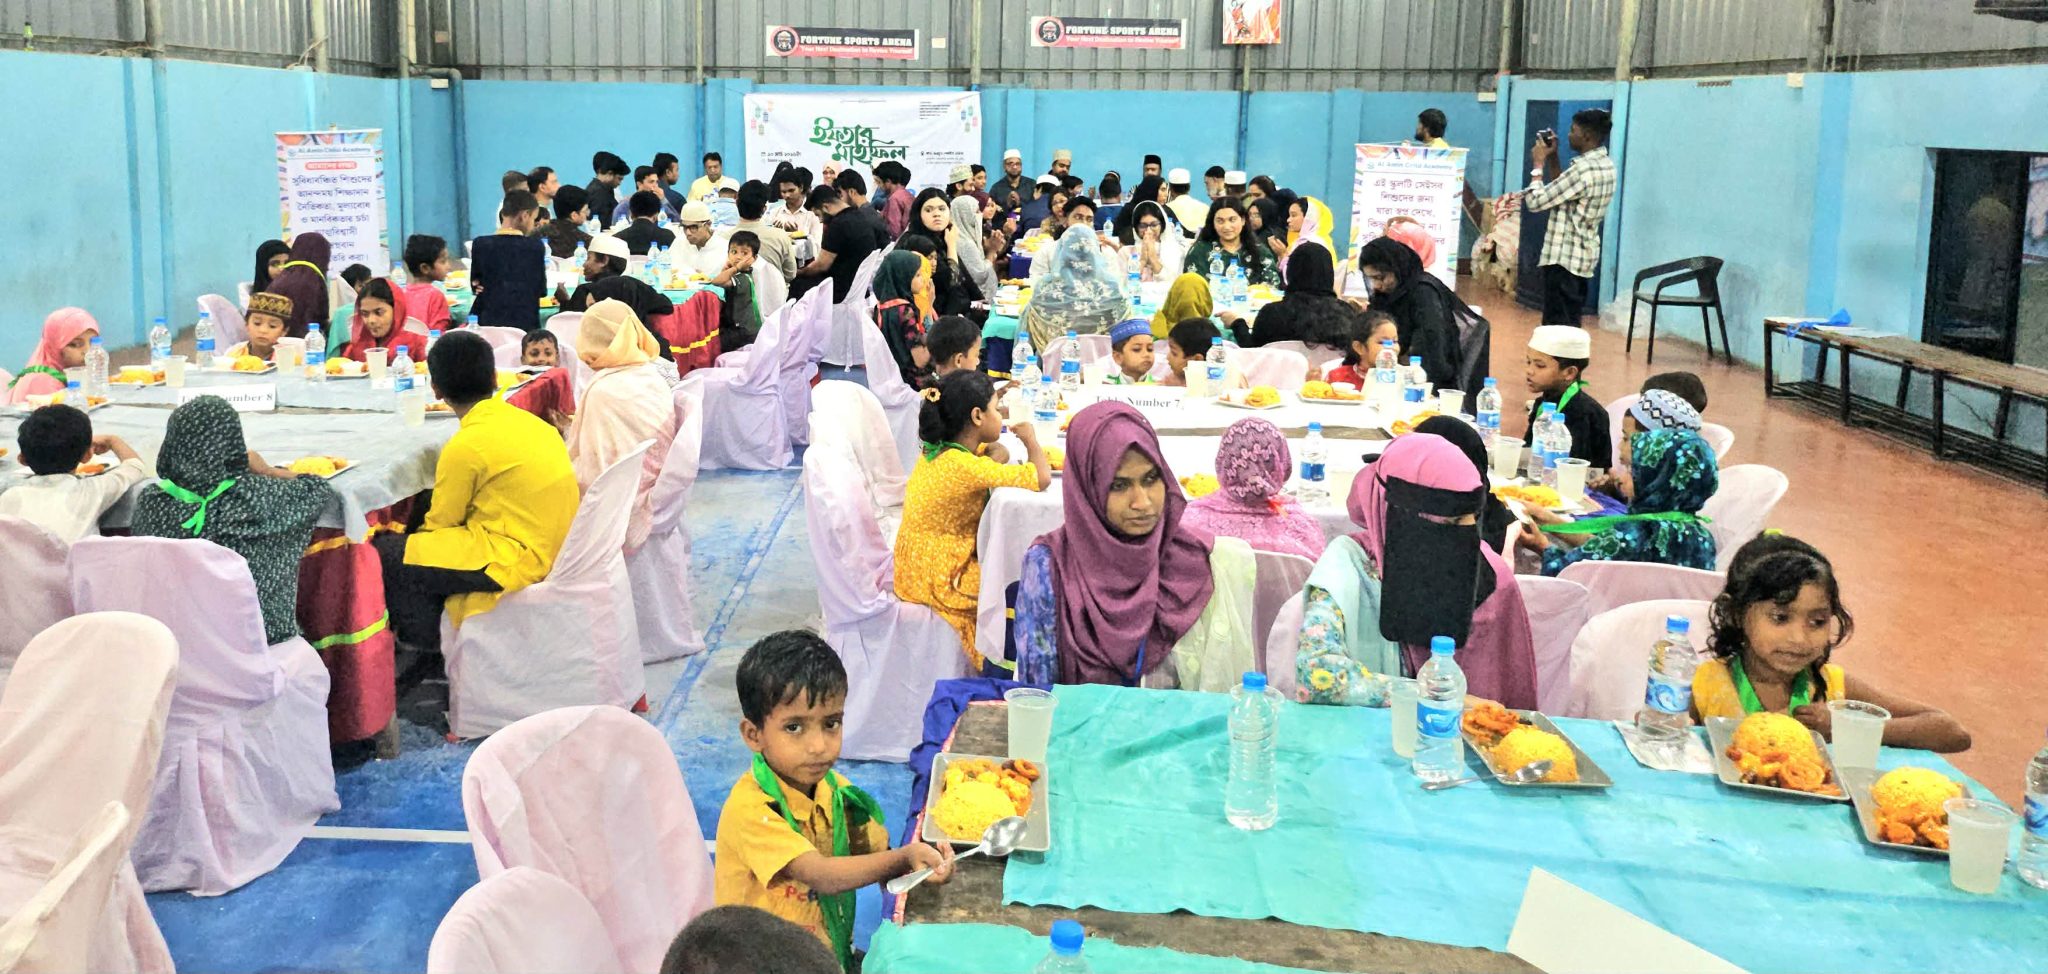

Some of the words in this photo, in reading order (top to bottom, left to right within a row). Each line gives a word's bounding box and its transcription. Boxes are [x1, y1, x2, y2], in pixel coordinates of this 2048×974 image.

[1065, 26, 1107, 34] FORTUNE
[1110, 26, 1145, 35] SPORTS
[1148, 27, 1179, 36] ARENA
[800, 35, 842, 44] FORTUNE
[844, 36, 879, 45] SPORTS
[882, 37, 912, 46] ARENA
[809, 116, 895, 147] ইফতার
[340, 174, 372, 184] শিশুদের
[1374, 178, 1386, 187] এই
[1381, 191, 1414, 202] শিশুদের
[1417, 195, 1434, 203] জন্য
[1376, 207, 1393, 215] যারা
[310, 213, 353, 224] মানবিকতার
[225, 393, 261, 402] umber
[266, 393, 273, 401] 8
